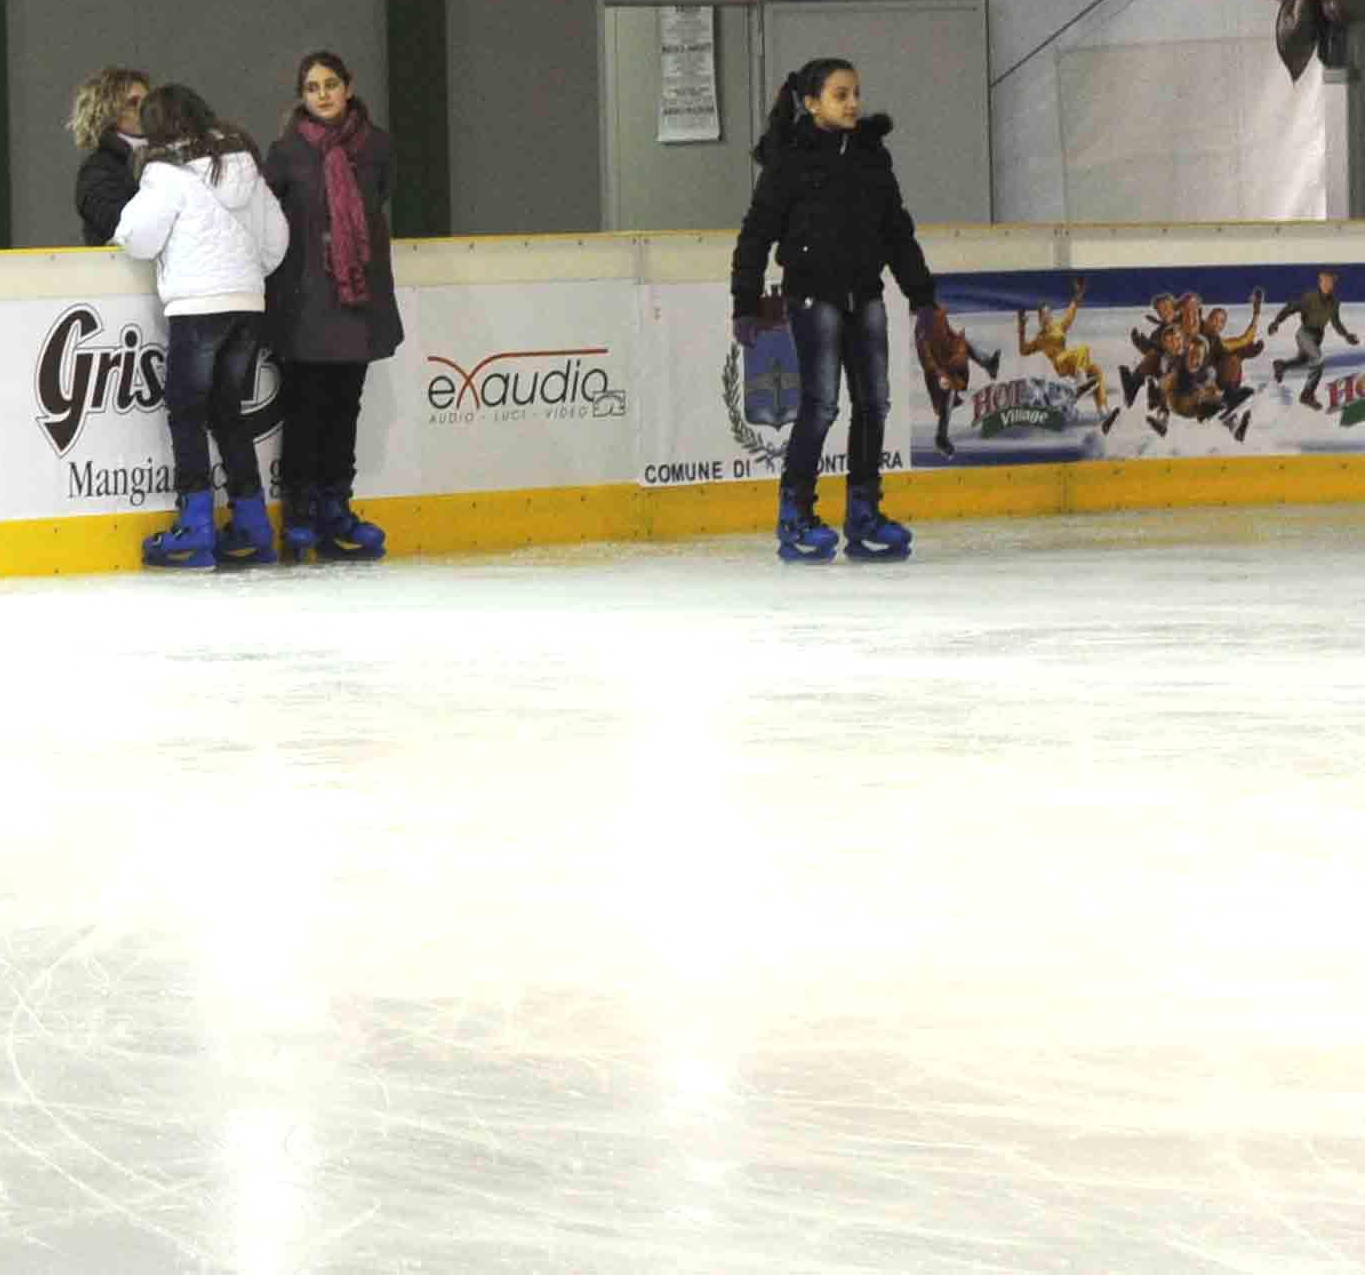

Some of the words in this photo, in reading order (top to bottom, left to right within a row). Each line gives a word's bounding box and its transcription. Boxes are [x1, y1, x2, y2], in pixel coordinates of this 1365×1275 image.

[429, 411, 475, 424] AUDIO
[546, 406, 587, 420] VIDEO
[1000, 408, 1048, 425] Village
[68, 458, 173, 506] Mangia
[644, 461, 723, 484] COMUNE
[733, 459, 751, 479] DI
